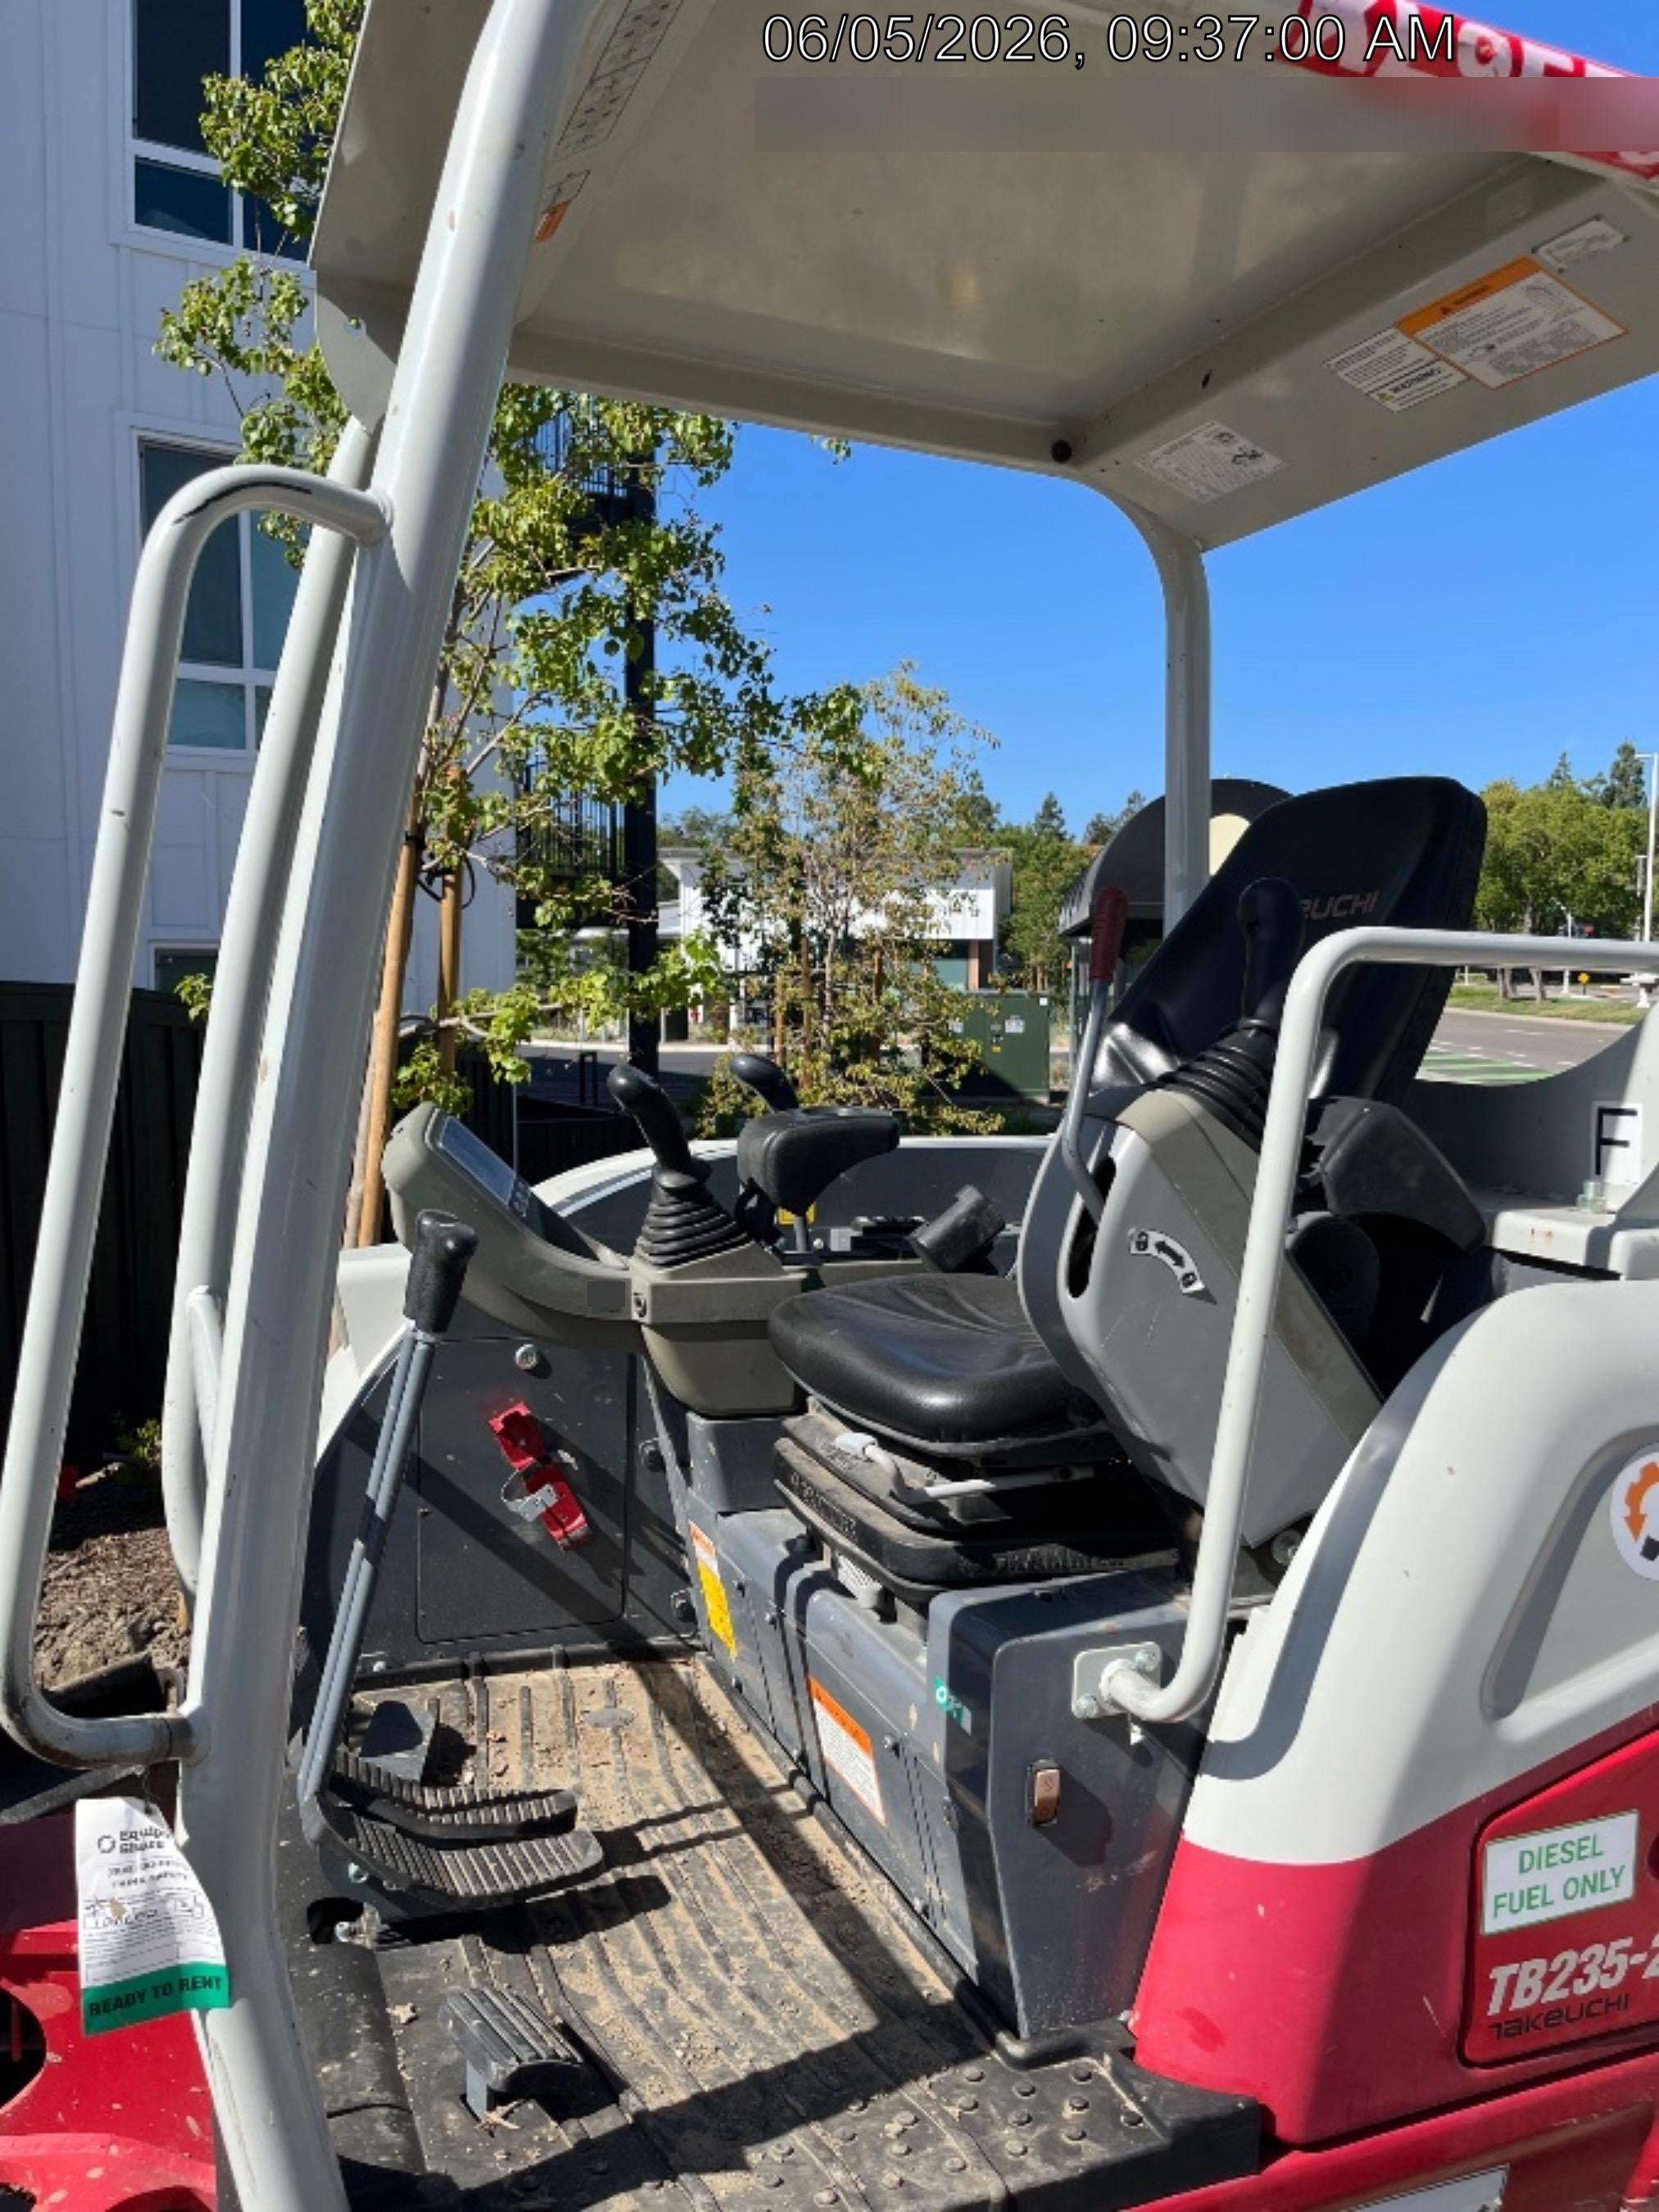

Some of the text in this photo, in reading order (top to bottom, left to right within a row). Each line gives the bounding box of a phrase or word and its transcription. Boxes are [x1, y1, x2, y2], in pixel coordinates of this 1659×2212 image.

[1595, 1107, 1638, 1175] F
[1518, 1834, 1603, 1875] DIESEL
[1494, 1865, 1625, 1919] FUEL ONLY
[88, 1974, 223, 2016] READY TO RENT
